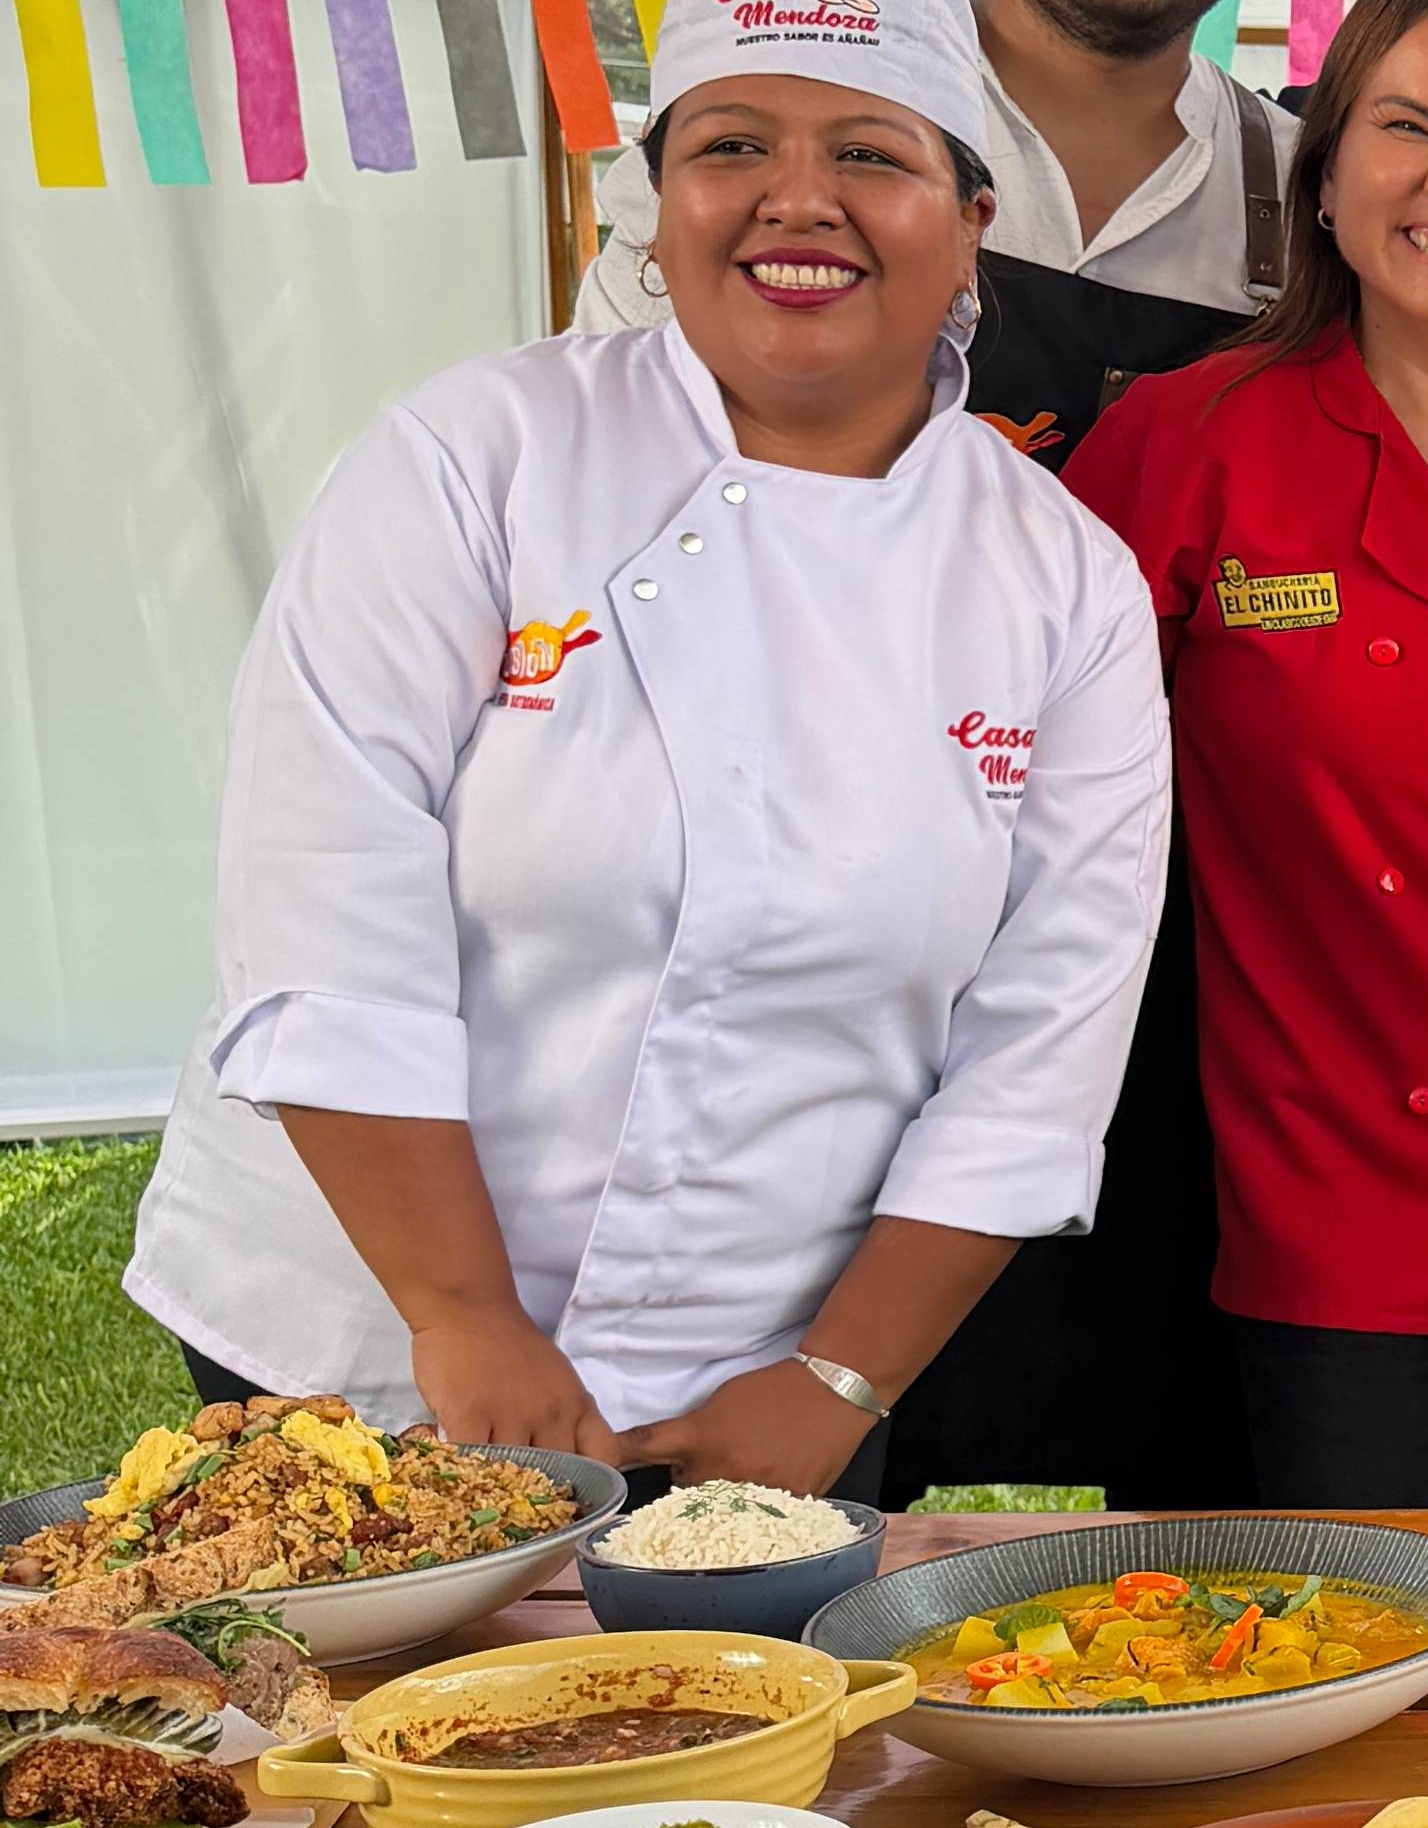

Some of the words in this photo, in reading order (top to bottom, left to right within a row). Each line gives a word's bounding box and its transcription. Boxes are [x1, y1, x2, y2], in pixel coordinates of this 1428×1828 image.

[733, 0, 881, 32] Mendoza
[736, 32, 781, 47] NUESTRO
[784, 32, 819, 43] SABOR
[822, 32, 834, 43] ES
[1224, 595, 1247, 614] EL
[1248, 588, 1332, 613] CHINITO
[947, 710, 1037, 750] Casa
